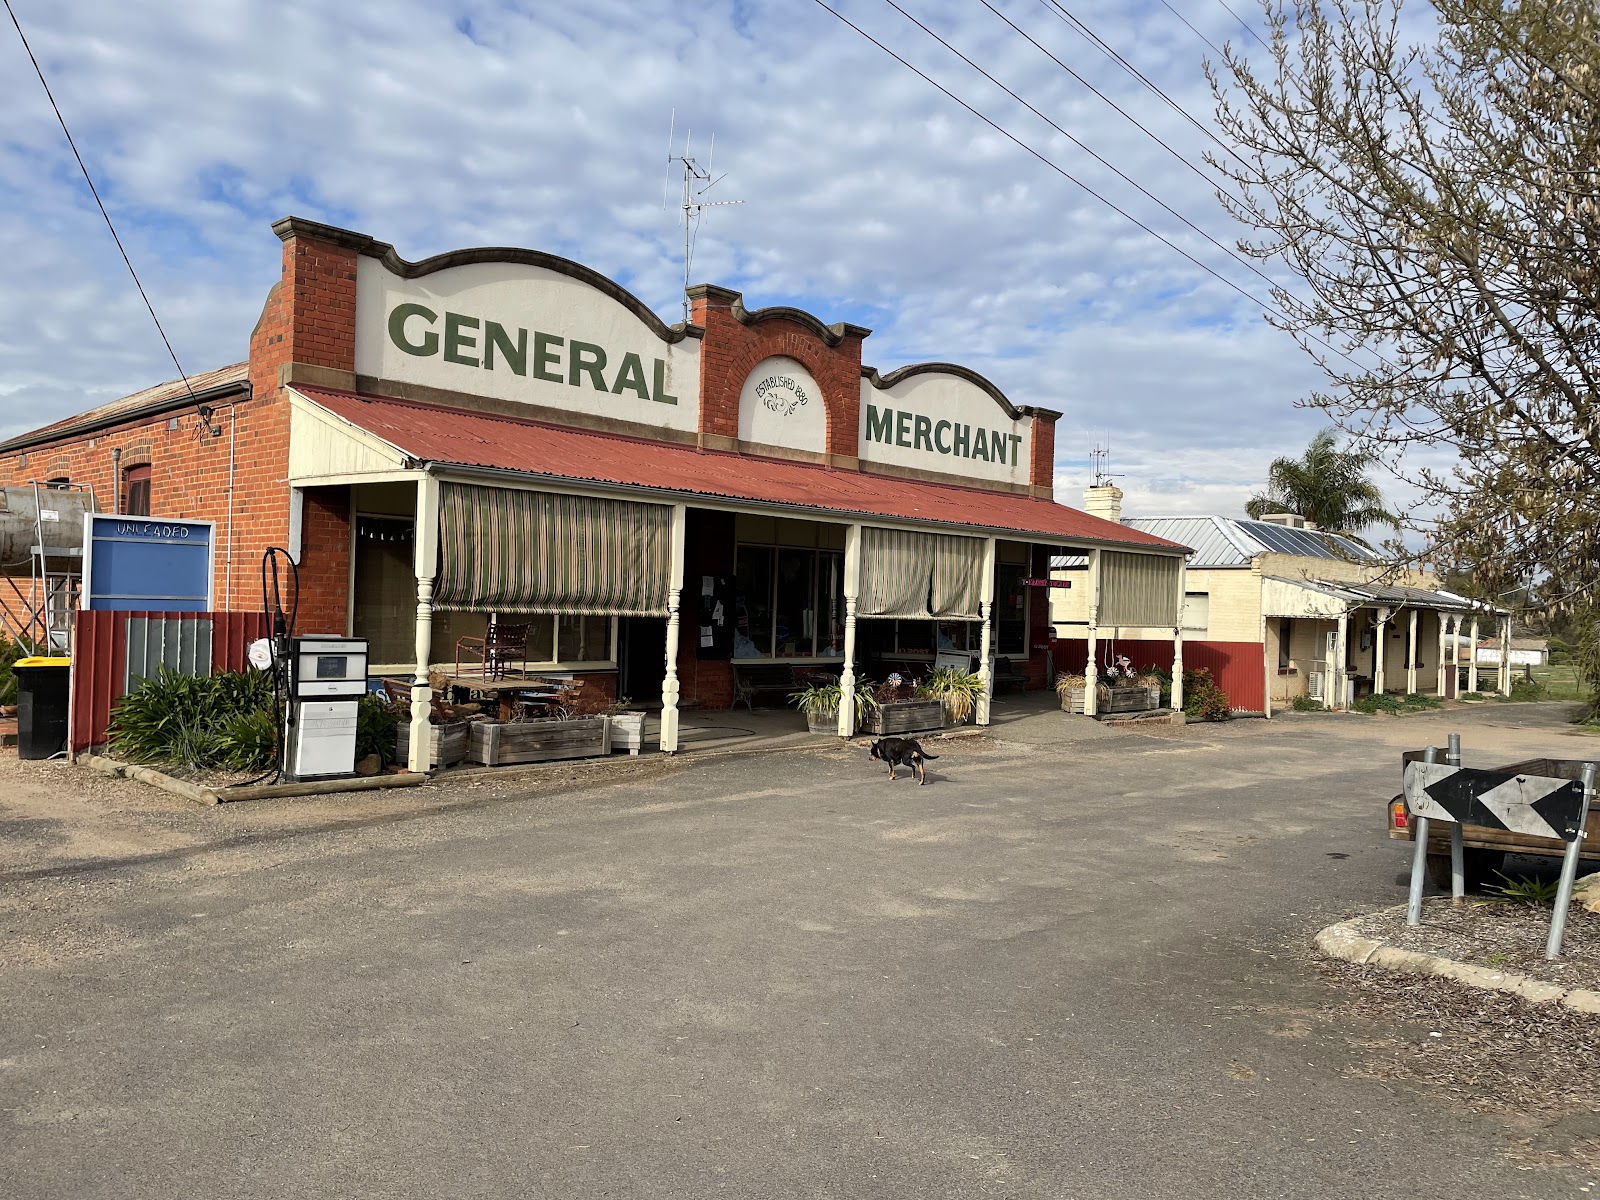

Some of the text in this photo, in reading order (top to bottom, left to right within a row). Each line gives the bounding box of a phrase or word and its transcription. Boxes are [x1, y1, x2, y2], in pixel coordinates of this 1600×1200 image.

[388, 302, 678, 406] GENERAL
[755, 376, 795, 398] ESTABLISHED
[866, 404, 1022, 466] MERCHANT
[117, 523, 189, 538] UNLEADED
